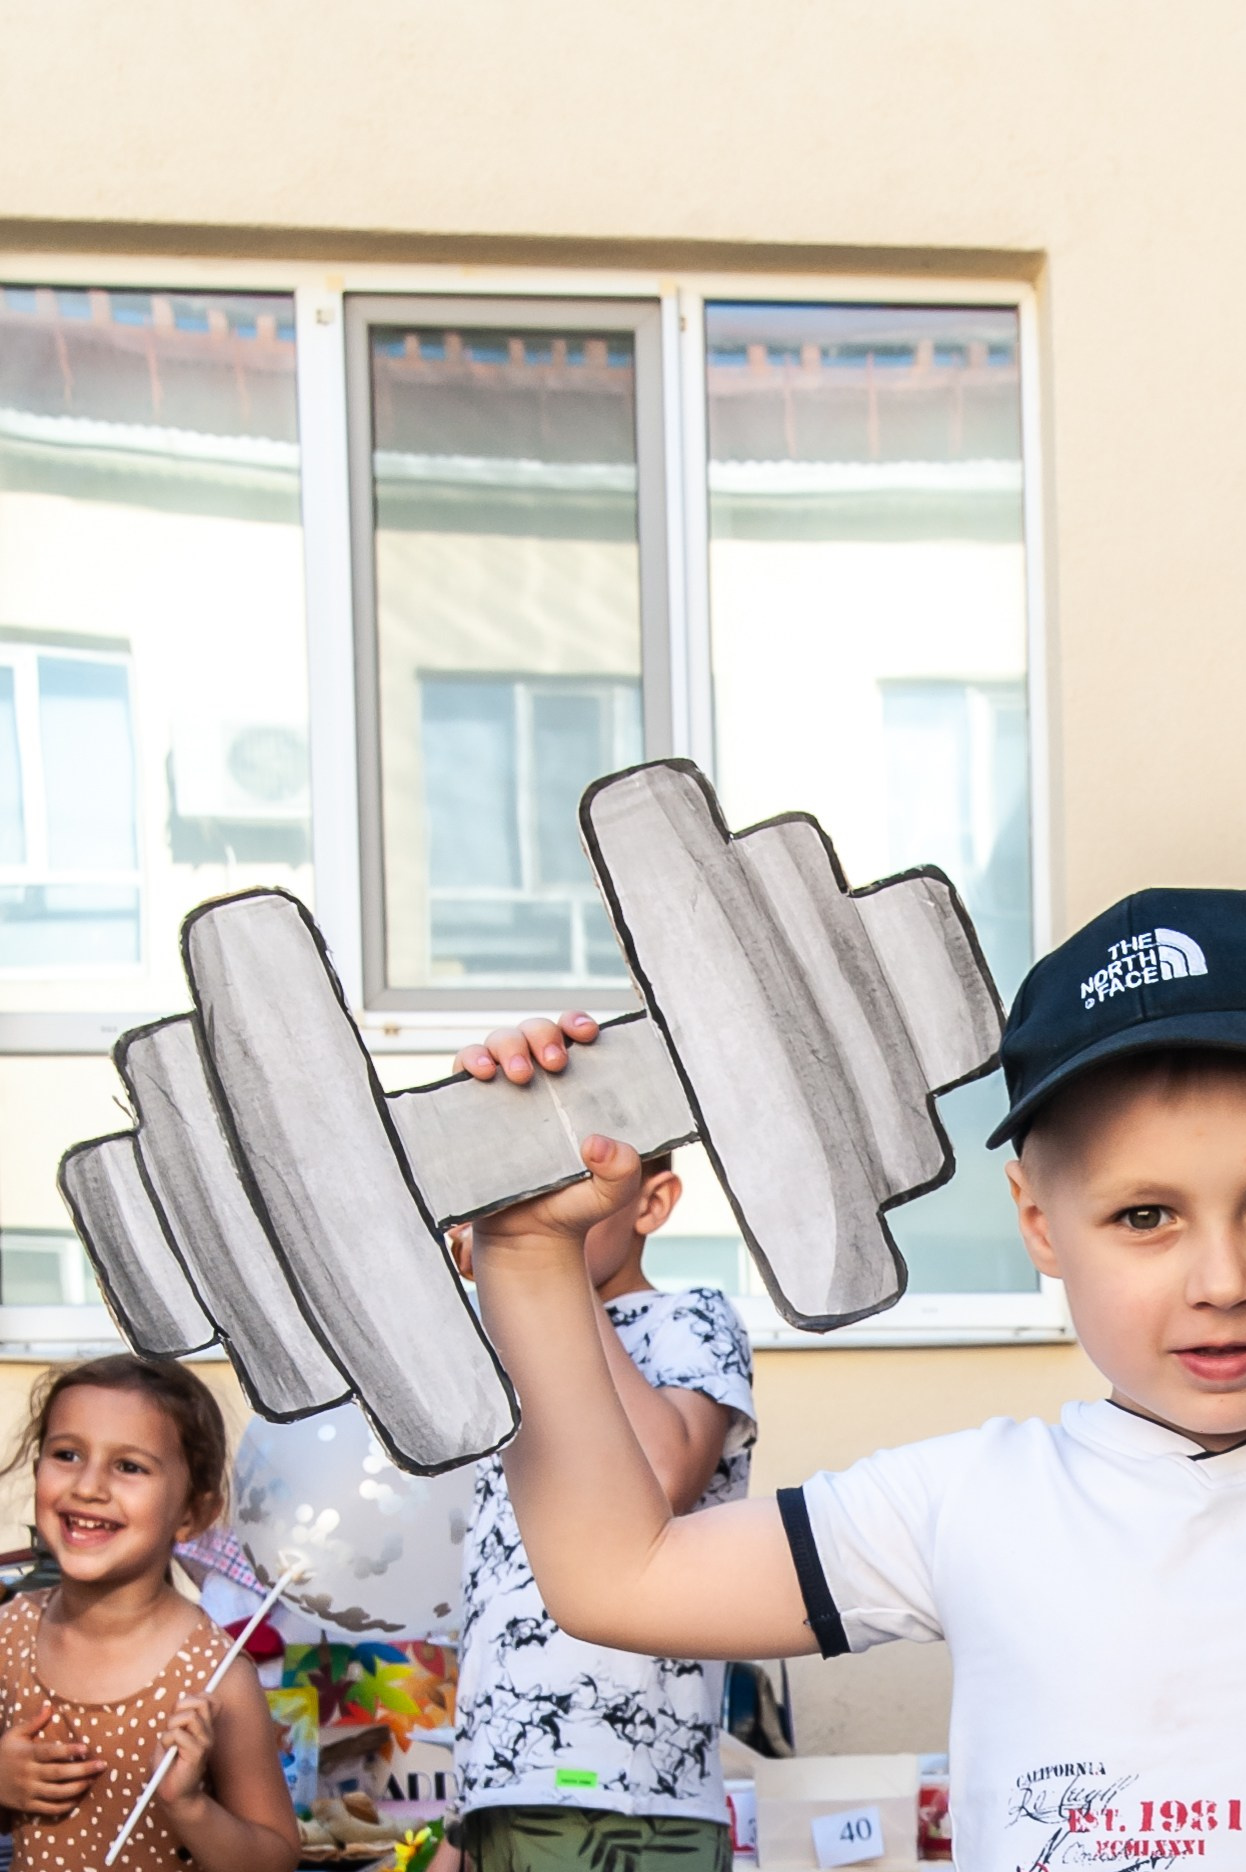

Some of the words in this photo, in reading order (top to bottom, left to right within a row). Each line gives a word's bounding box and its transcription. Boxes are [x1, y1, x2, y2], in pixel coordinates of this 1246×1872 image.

[1107, 932, 1153, 961] THE
[1080, 949, 1158, 999] NORTH
[1097, 966, 1159, 1002] FACE
[1016, 1762, 1106, 1788] CALIFORNIA
[839, 1817, 872, 1844] 40
[1139, 1799, 1243, 1832] 1981
